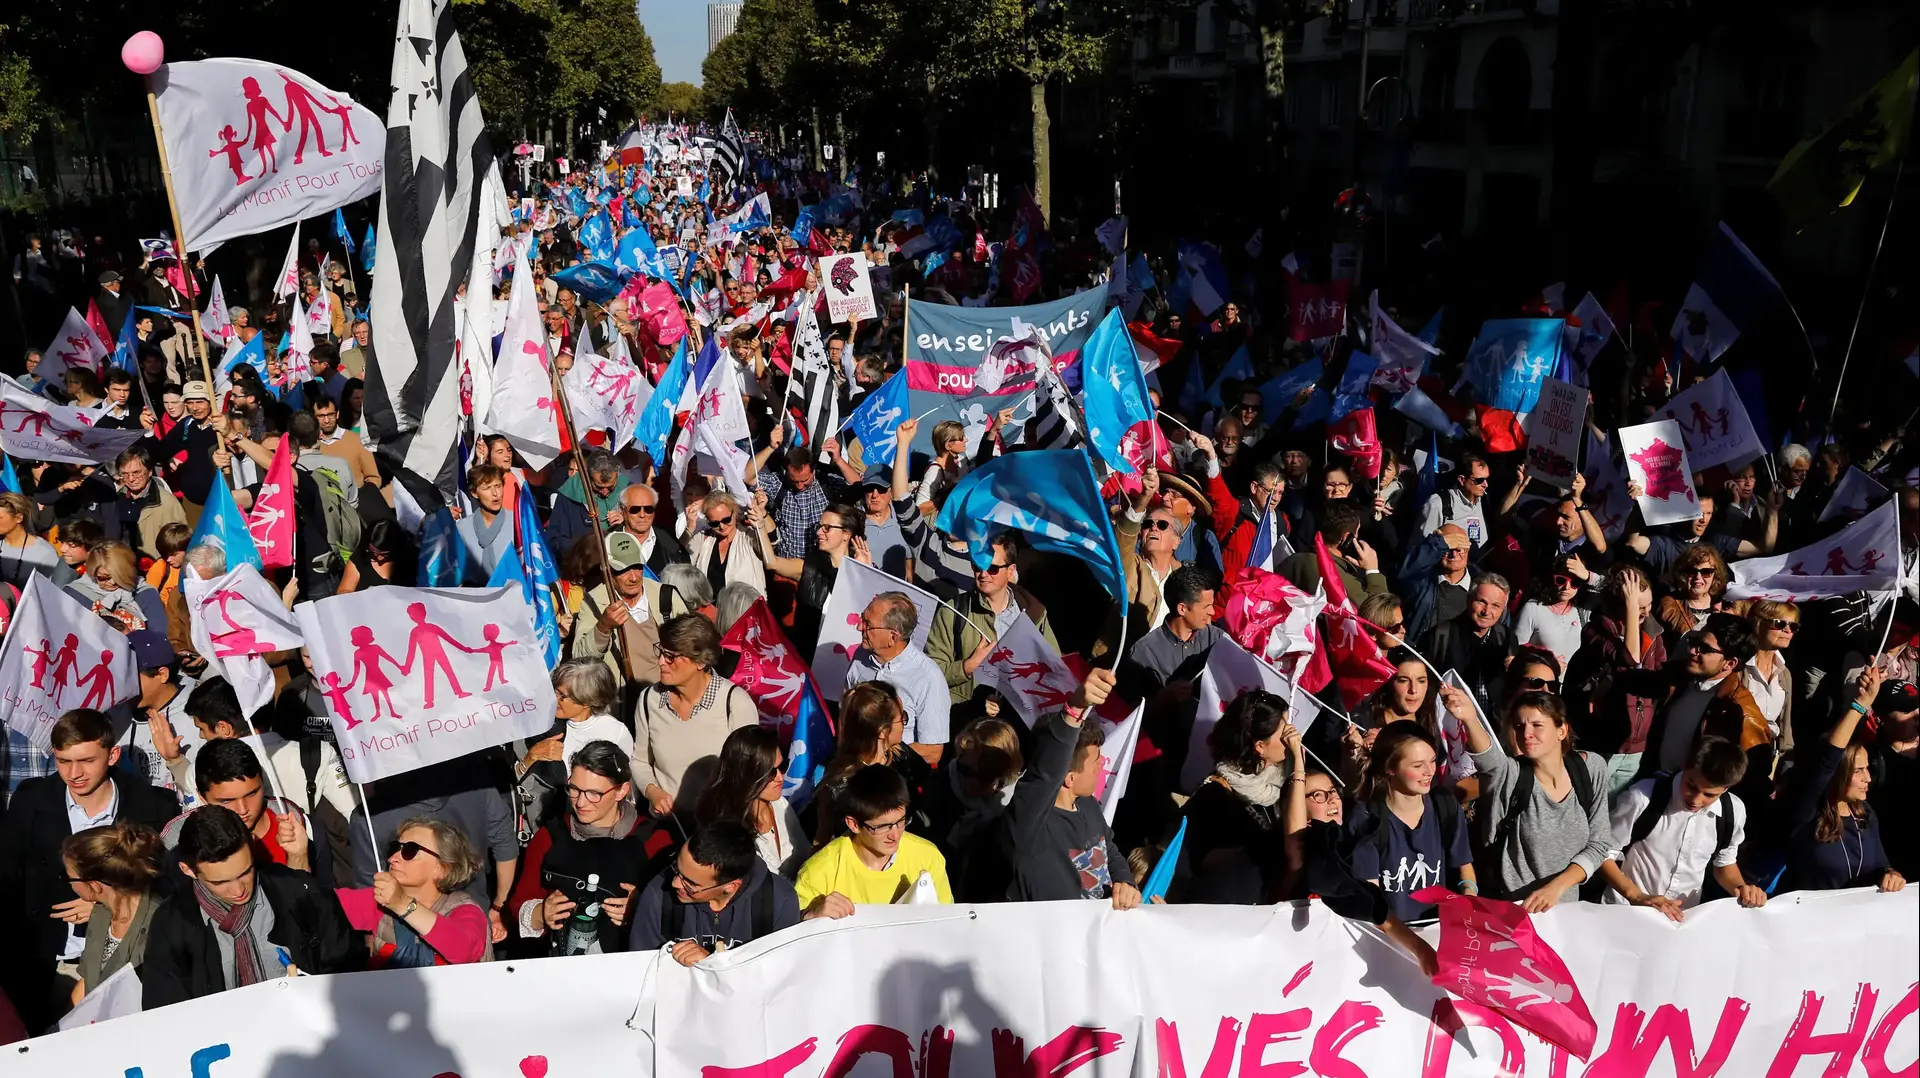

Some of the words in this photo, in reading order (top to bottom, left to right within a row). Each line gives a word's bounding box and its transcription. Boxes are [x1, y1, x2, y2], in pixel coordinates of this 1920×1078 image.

[242, 179, 292, 211] Manif
[295, 171, 340, 193] Pour
[342, 159, 384, 180] Tous
[938, 372, 978, 389] pou
[3, 685, 23, 708] La
[25, 698, 57, 727] Man
[359, 724, 421, 757] Manif
[426, 710, 480, 738] Pour
[484, 697, 537, 720] Tous
